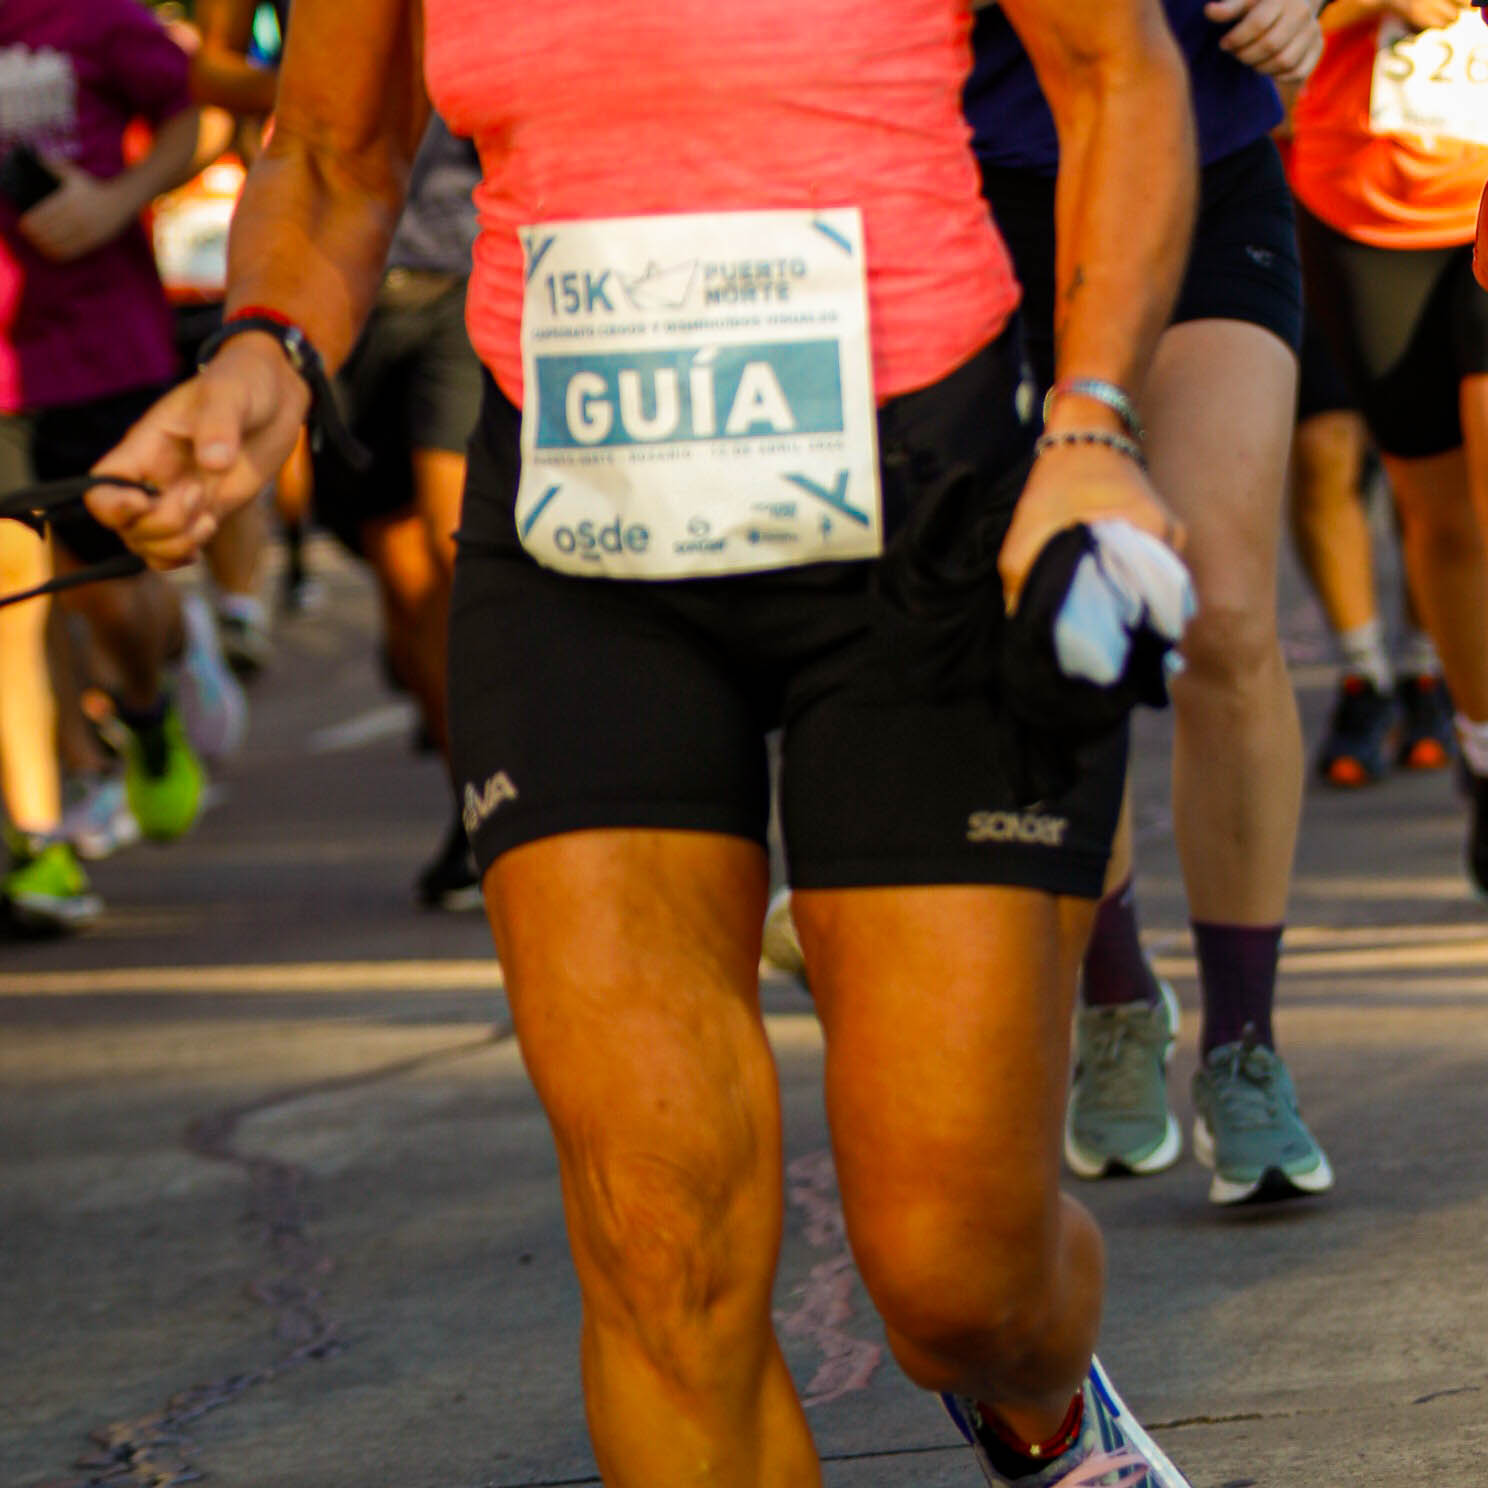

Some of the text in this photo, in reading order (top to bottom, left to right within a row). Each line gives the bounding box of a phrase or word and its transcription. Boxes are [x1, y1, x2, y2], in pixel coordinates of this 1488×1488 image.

[704, 257, 807, 279] PUERTO
[545, 269, 615, 314] 15K
[705, 280, 792, 306] NORTE
[565, 346, 796, 446] GUÍA
[553, 513, 652, 560] osde
